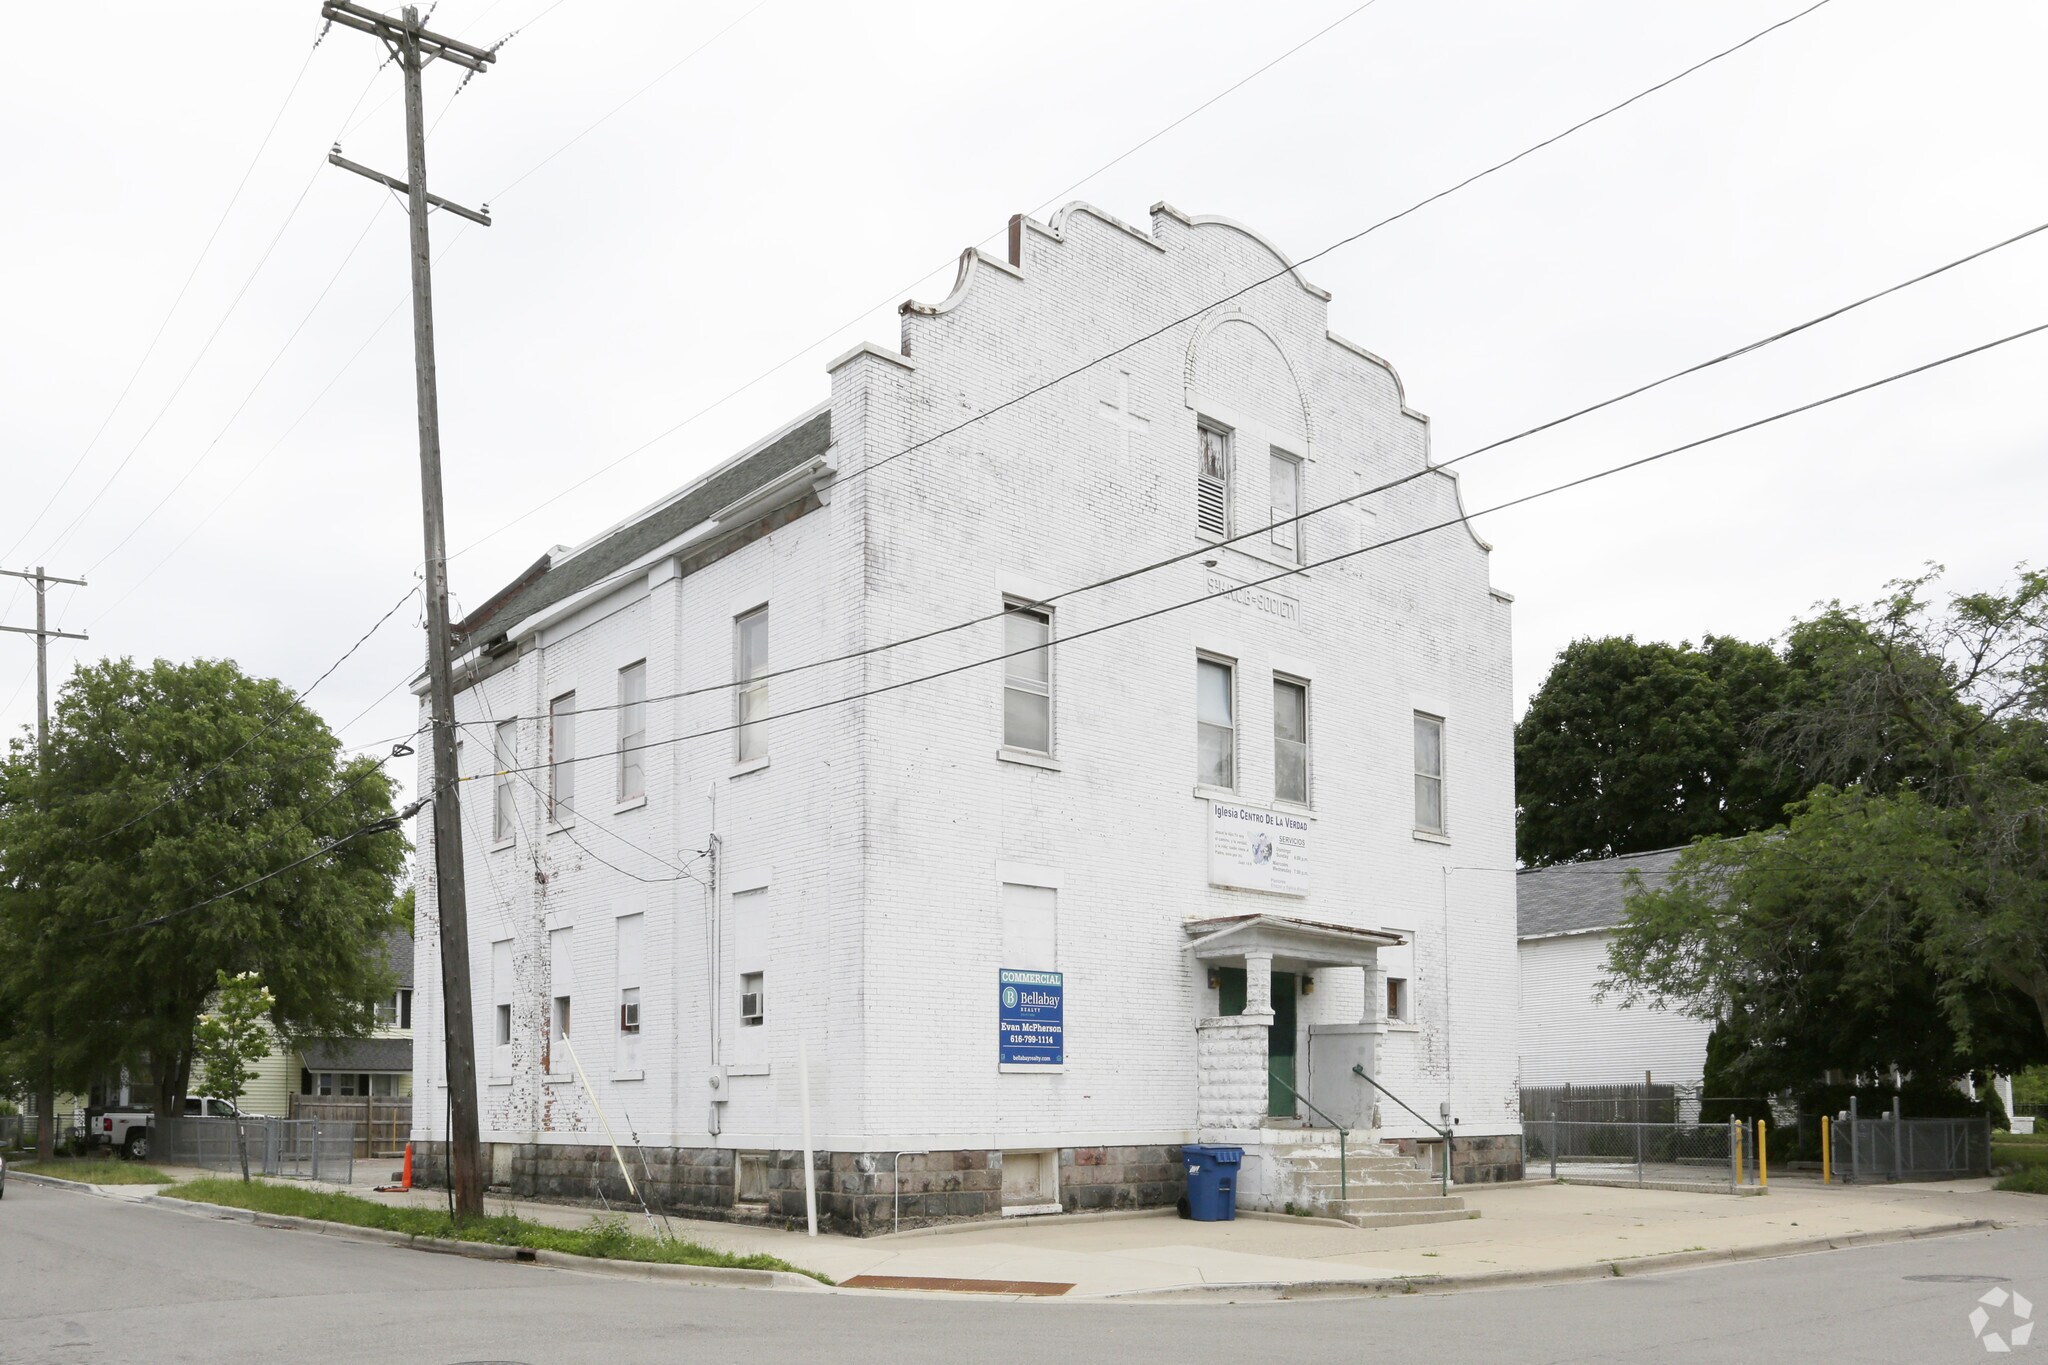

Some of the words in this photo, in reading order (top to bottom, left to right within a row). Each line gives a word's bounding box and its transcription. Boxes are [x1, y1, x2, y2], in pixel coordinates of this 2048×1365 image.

[1214, 804, 1238, 819] Iglesia
[1239, 809, 1264, 824] CENTRO
[1265, 813, 1274, 825] DE
[1275, 816, 1284, 827] LA
[1285, 817, 1308, 831] VERDAD
[1278, 835, 1306, 846] SERVICIOS
[1002, 972, 1061, 984] COMMERCIAL
[1007, 990, 1015, 1004] B
[1020, 991, 1060, 1009] Bellabay
[1001, 1022, 1020, 1032] Evan
[1021, 1023, 1062, 1033] McPherson
[1010, 1034, 1054, 1044] 616-799-1114
